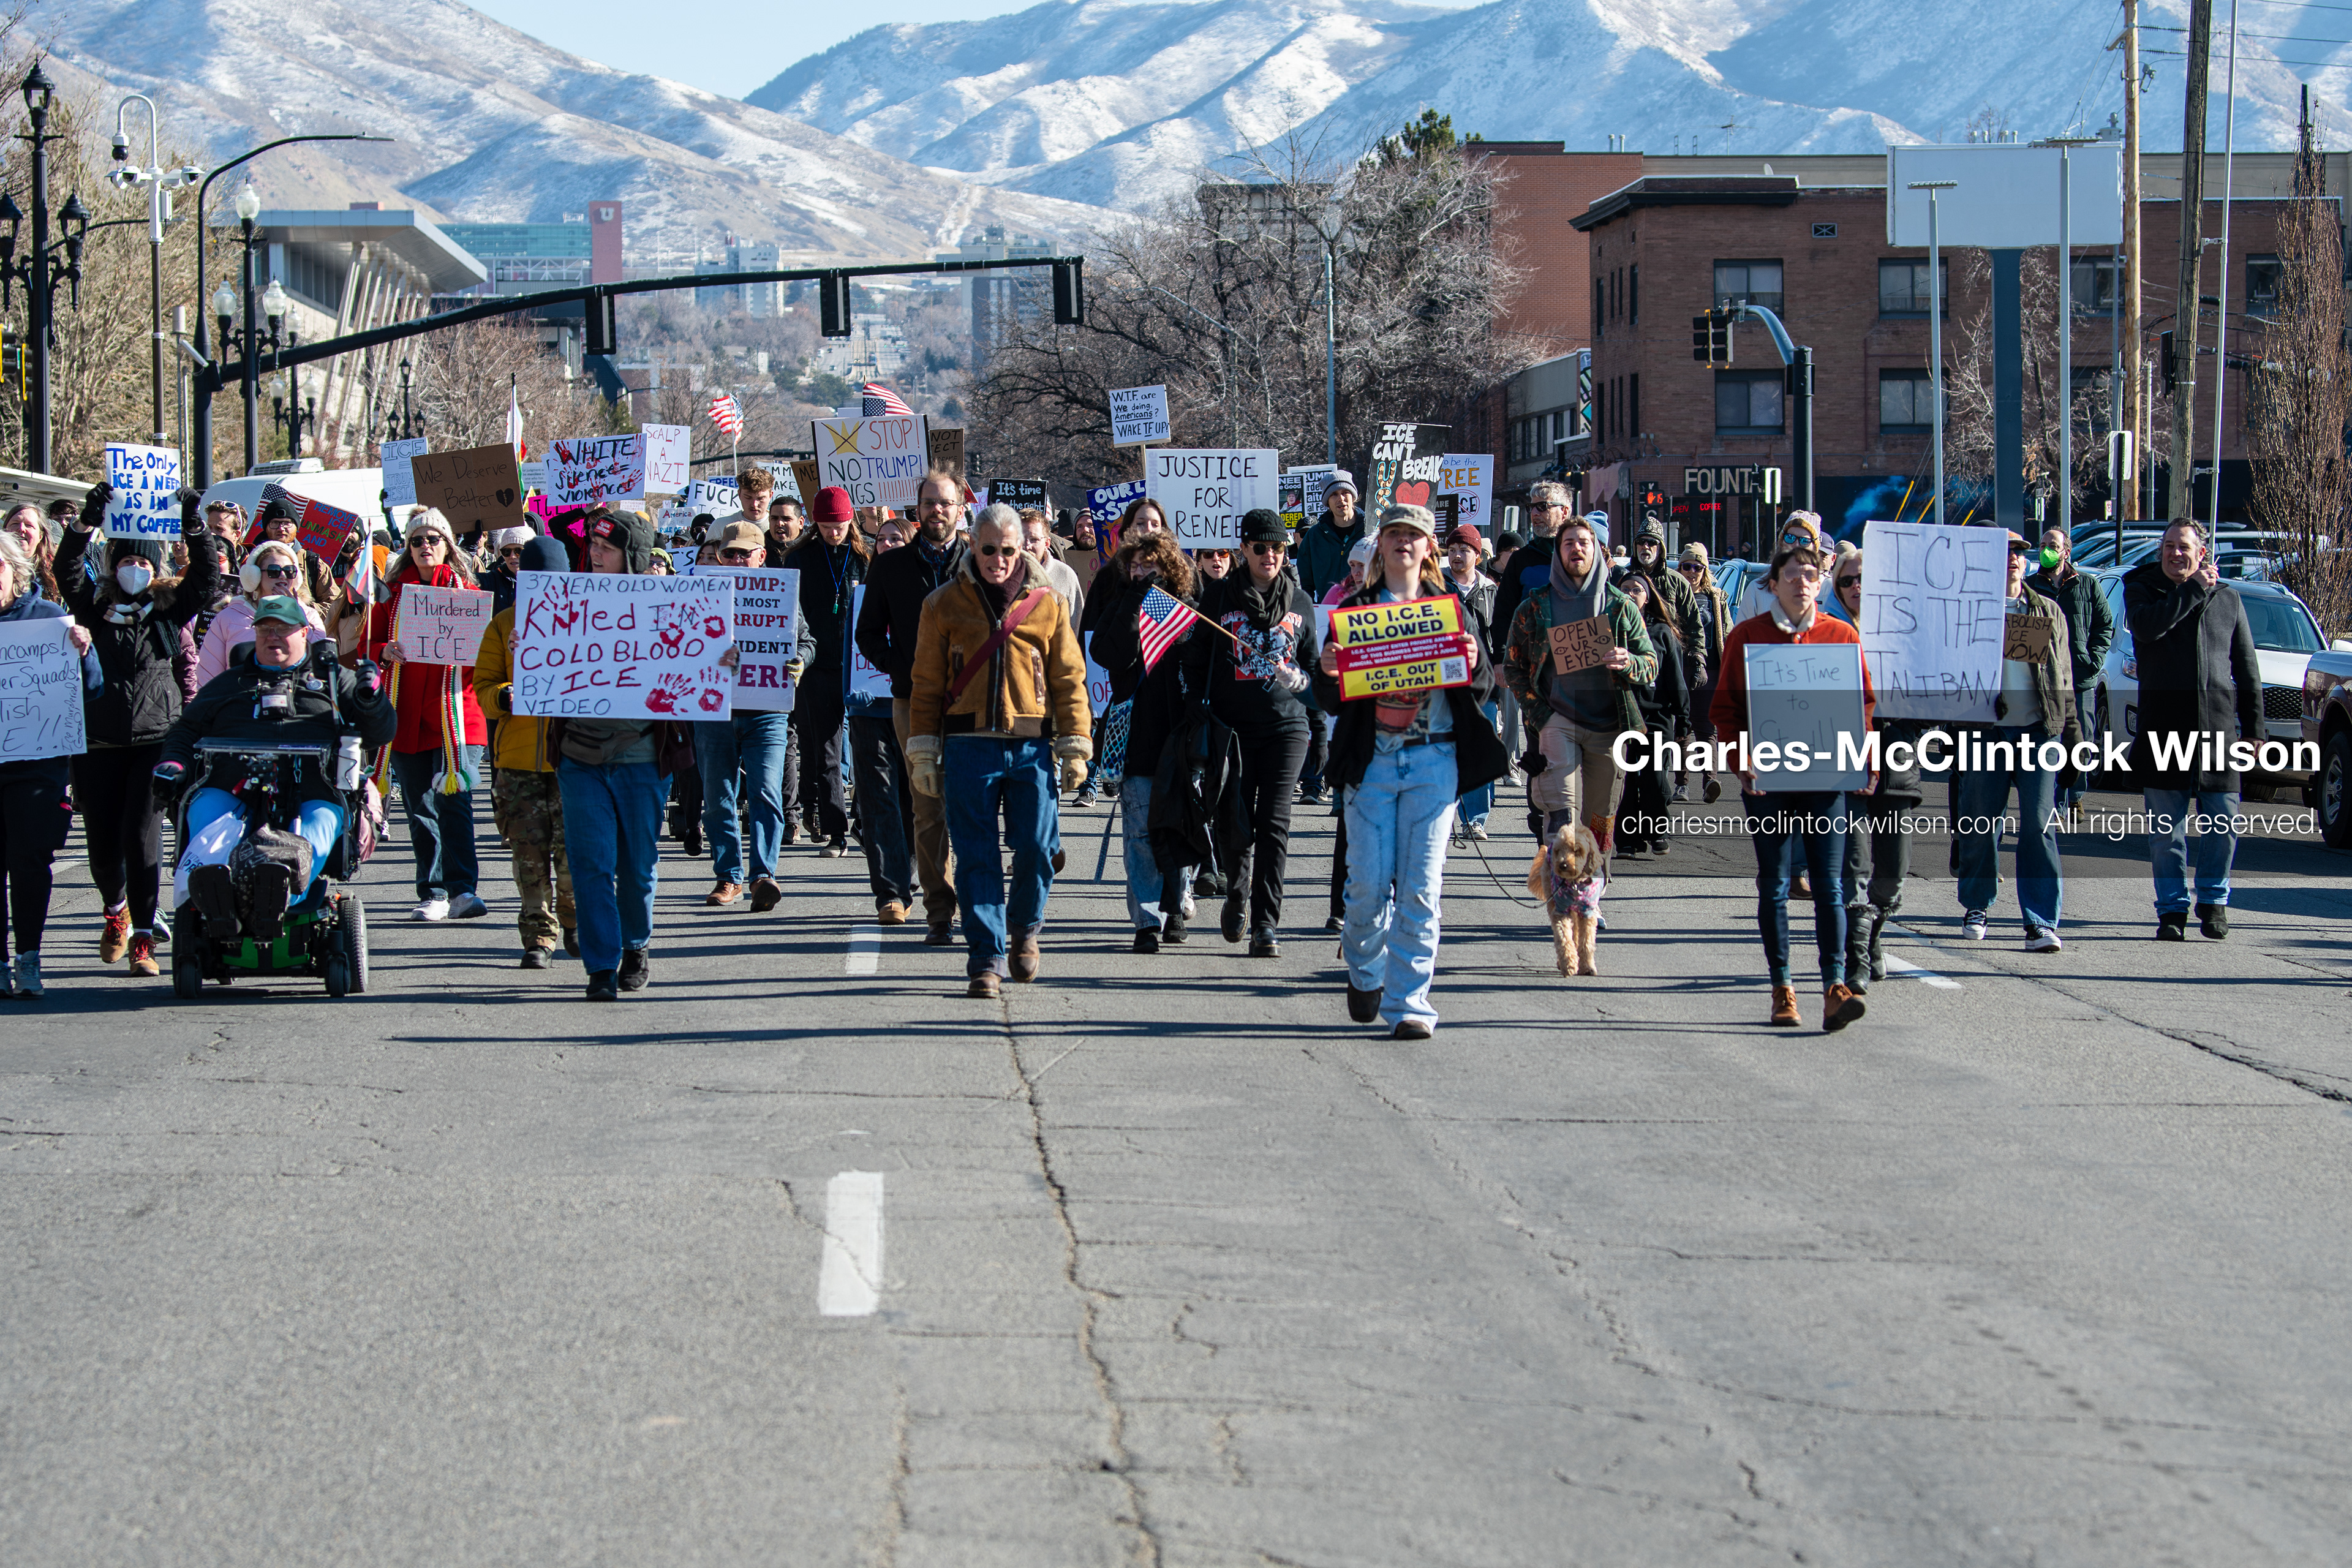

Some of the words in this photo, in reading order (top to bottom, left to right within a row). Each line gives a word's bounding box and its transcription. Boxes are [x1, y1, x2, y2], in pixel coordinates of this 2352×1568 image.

[600, 208, 614, 221] U
[869, 418, 920, 450] STOP!
[931, 431, 960, 442] NOT
[1116, 424, 1141, 437] WAKE
[1144, 421, 1154, 435] TF
[1155, 421, 1169, 434] UP!
[1382, 424, 1417, 443] ICE
[384, 439, 424, 461] ICE
[555, 437, 638, 466] WHITE
[660, 447, 666, 461] A
[1373, 442, 1416, 461] CAN'T
[106, 448, 143, 470] The
[146, 452, 177, 475] Only
[415, 462, 443, 484] We
[452, 456, 507, 479] Deserve
[828, 458, 861, 482] NO
[861, 454, 923, 479] TRUMP!
[1159, 456, 1258, 481] JUSTICE
[1402, 455, 1444, 483] BREAK
[1451, 457, 1461, 466] be
[1464, 457, 1477, 466] the
[647, 462, 684, 484] NAZI
[695, 483, 739, 508] FUCK
[774, 481, 796, 490] AKE
[826, 482, 875, 505] NGS
[996, 482, 1016, 496] It's
[1019, 482, 1041, 496] time
[1095, 484, 1134, 503] OUR
[444, 488, 494, 509] Better
[1195, 487, 1232, 508] FOR
[111, 513, 134, 532] MY
[137, 514, 181, 534] COFFEE
[314, 502, 357, 524] REMOVE
[663, 510, 692, 518] America
[300, 519, 345, 543] UNMASK
[328, 518, 352, 530] ICE!
[1176, 511, 1244, 538] RENEE
[303, 534, 326, 547] AND
[1877, 530, 1993, 595] ICE
[527, 575, 552, 590] 37
[559, 576, 611, 595] YEAR
[617, 579, 655, 593] OLD
[660, 576, 731, 593] WOMEN
[414, 593, 479, 617] Murdered
[742, 597, 780, 608] MOST
[648, 603, 699, 631] IN
[1348, 612, 1378, 627] NO
[1387, 605, 1441, 622] I.C.E.
[1865, 594, 1918, 635] IS
[1928, 595, 2002, 648] THE
[439, 617, 453, 639] by
[1348, 619, 1443, 643] ALLOWED
[1554, 619, 1598, 643] OPEN
[2008, 630, 2029, 642] ICE
[417, 636, 466, 660] ICE
[521, 643, 603, 670] COLD
[614, 639, 704, 662] BLOOD
[734, 640, 792, 654] IDENT
[1384, 647, 1411, 657] BUSINESS
[1412, 644, 1438, 652] WITHOUT
[1571, 640, 1592, 652] UR
[1374, 655, 1402, 664] WARRANT
[1564, 649, 1600, 670] EYES
[522, 674, 555, 696] BY
[560, 666, 641, 695] ICE
[1365, 668, 1401, 681] I.C.E.
[1408, 662, 1437, 674] OUT
[1756, 660, 1797, 687] It's
[1798, 657, 1841, 684] Time
[1864, 650, 1997, 706] TALIBAN
[1371, 681, 1390, 692] OF
[1395, 675, 1435, 688] UTAH
[525, 699, 610, 715] VIDEO
[1787, 693, 1809, 710] to
